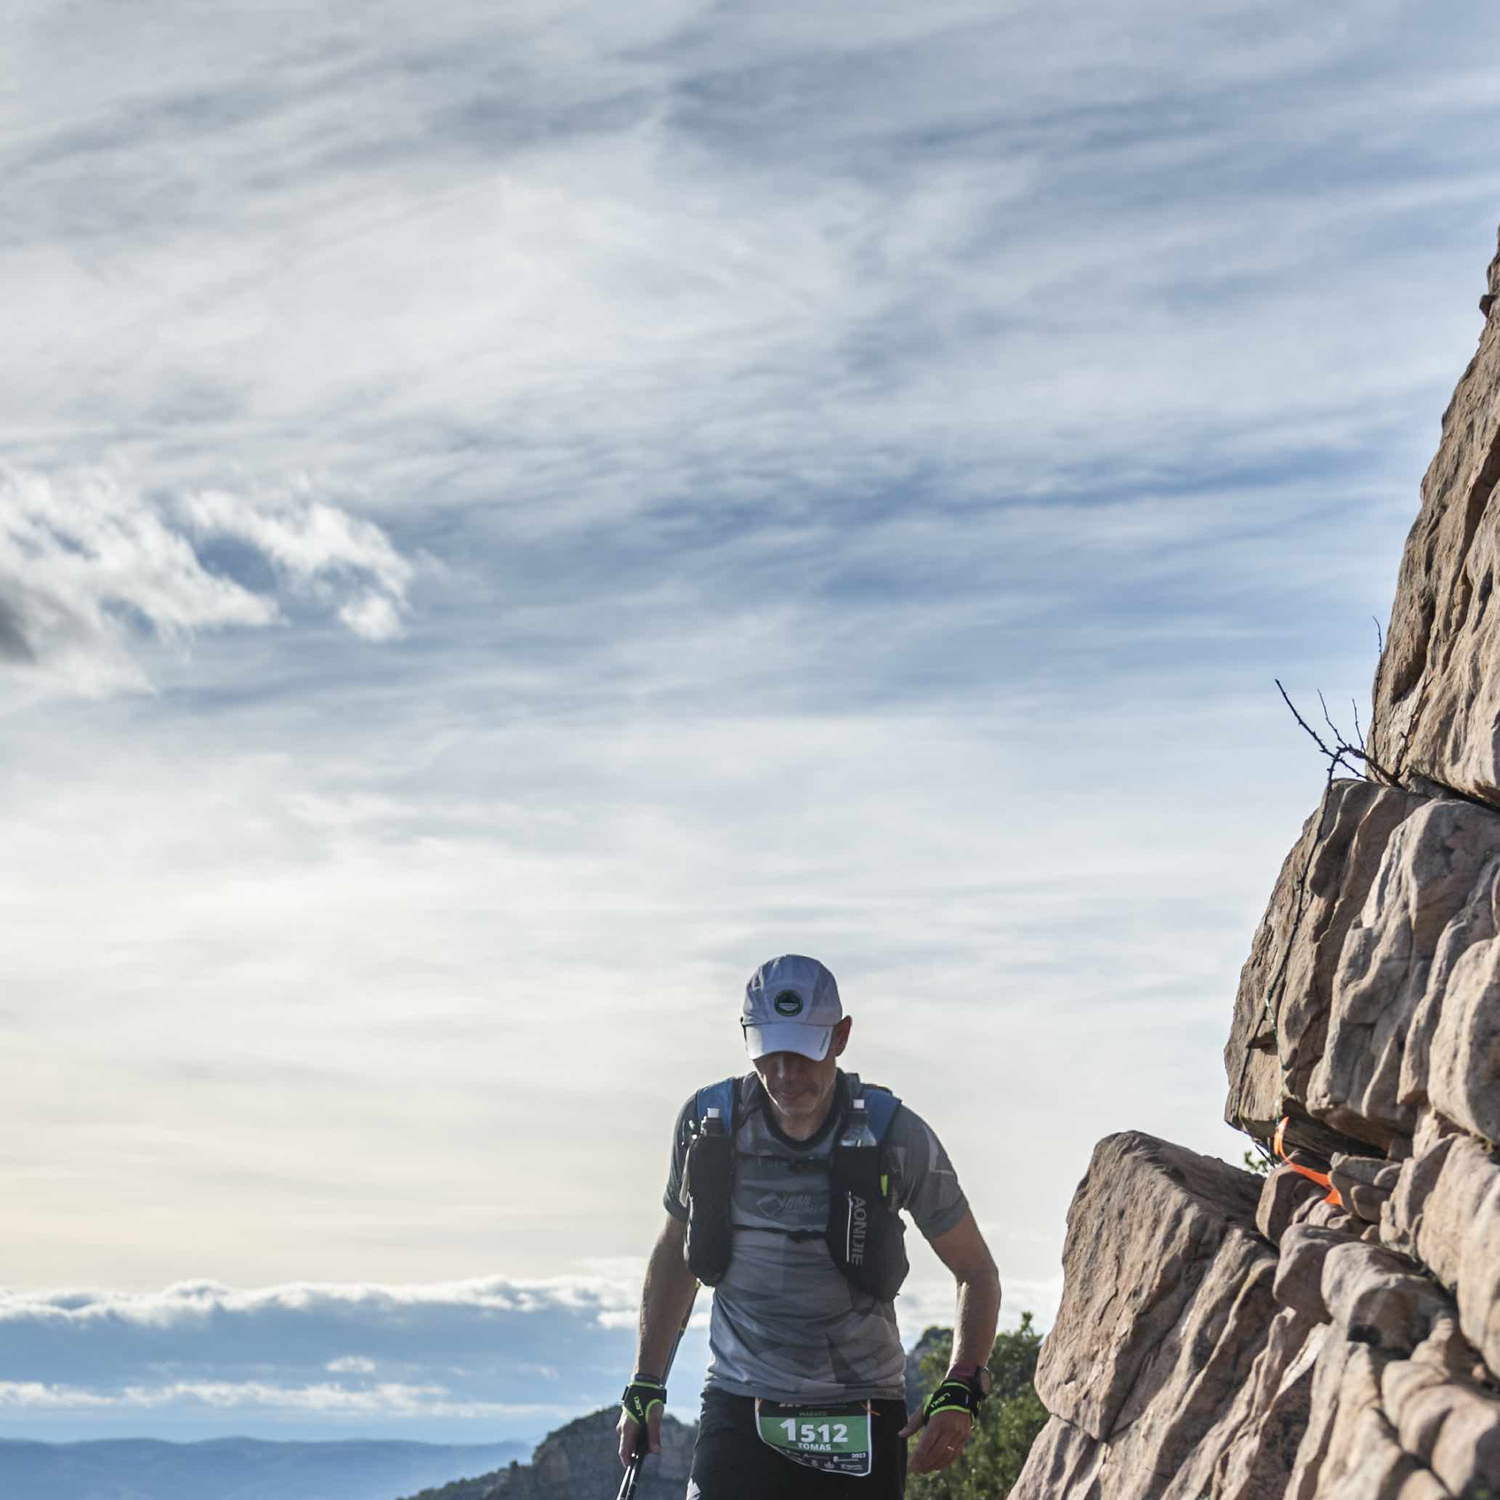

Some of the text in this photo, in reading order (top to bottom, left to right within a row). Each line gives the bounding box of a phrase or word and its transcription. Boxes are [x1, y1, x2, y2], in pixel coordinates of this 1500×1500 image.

[851, 1196, 867, 1267] AONIJIE
[779, 1418, 849, 1443] 1512
[798, 1443, 832, 1451] TOMAS
